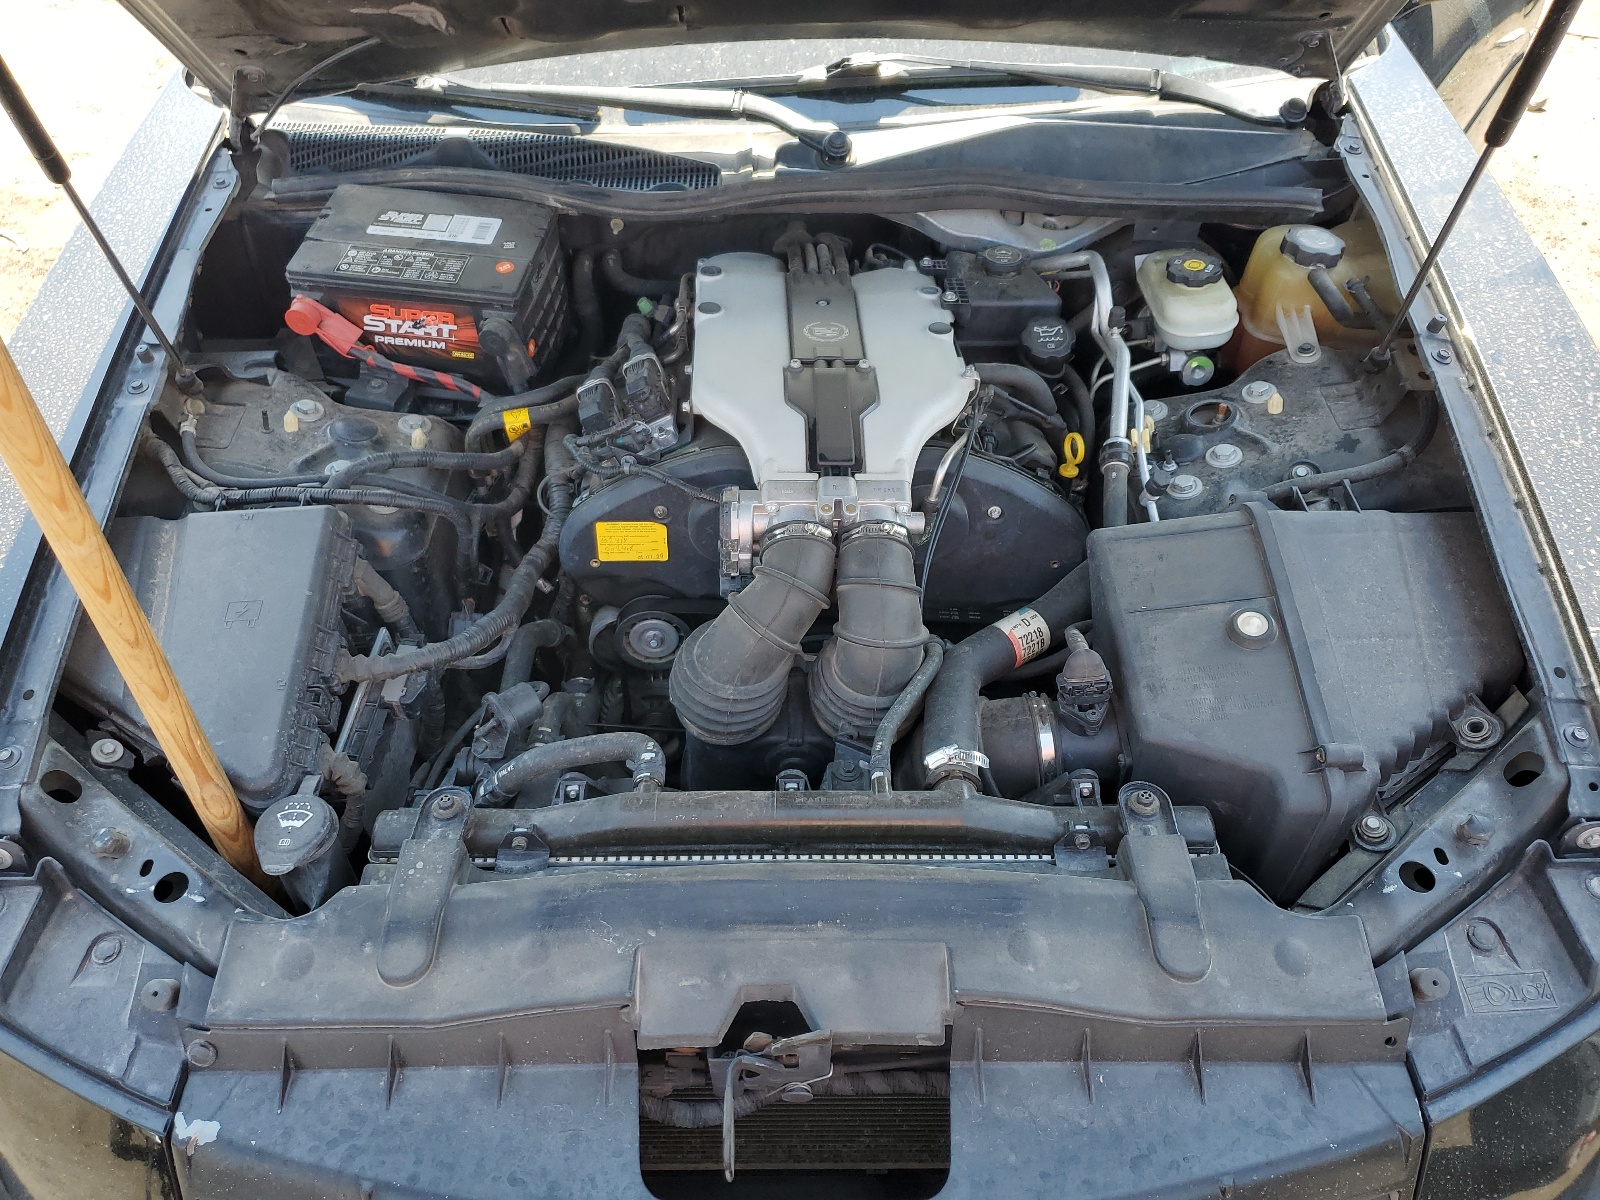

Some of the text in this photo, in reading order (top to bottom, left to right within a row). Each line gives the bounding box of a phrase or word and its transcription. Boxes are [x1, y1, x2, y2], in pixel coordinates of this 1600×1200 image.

[370, 304, 455, 325] SUPER
[363, 315, 457, 338] START
[375, 335, 446, 350] PREMIUM
[1021, 618, 1031, 627] D
[1018, 627, 1043, 647] 72218
[1022, 638, 1045, 658] 72218
